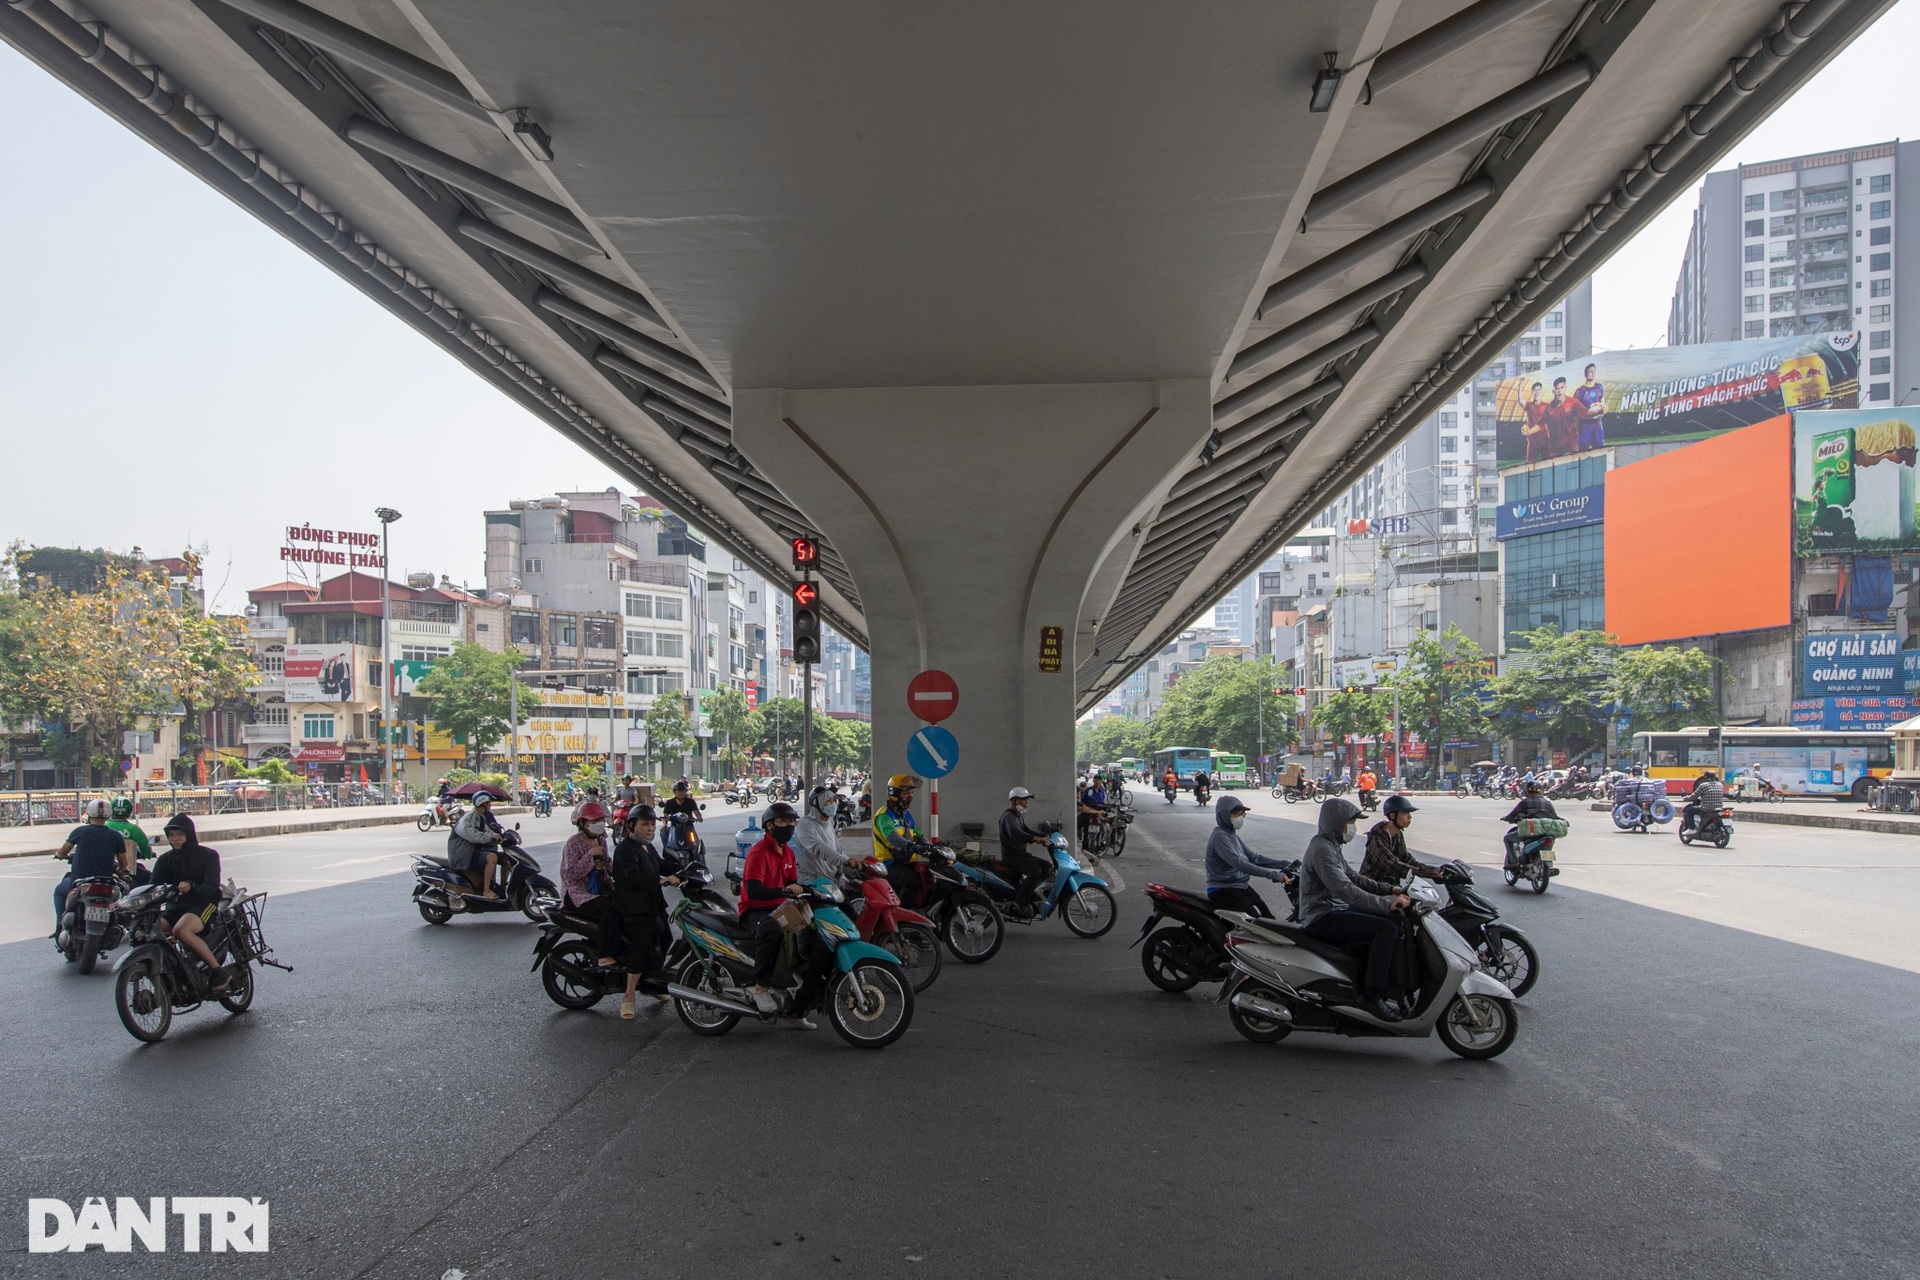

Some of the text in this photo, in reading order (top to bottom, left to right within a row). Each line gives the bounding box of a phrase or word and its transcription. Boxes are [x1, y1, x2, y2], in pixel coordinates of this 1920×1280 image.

[1833, 335, 1851, 346] tcp
[1620, 354, 1779, 410] NĂNG LƯỢNG TÍCH CỰC
[1637, 376, 1768, 425] HÚC TUNG THÁCH THỨC
[1818, 442, 1845, 458] MILO
[1529, 495, 1589, 515] TC Group
[1370, 517, 1411, 534] SHB
[289, 521, 379, 549] ĐỒNG PHỤC
[280, 547, 346, 566] PHƯƠNG
[797, 543, 813, 560] 51
[1808, 633, 1897, 662] CHỢ HẢI SẢN
[1812, 663, 1894, 682] QUẢNG NINH
[1296, 687, 1306, 695] 51
[1846, 684, 1861, 692] ship
[1863, 684, 1880, 692] hàng
[551, 692, 570, 704] CÔNG
[1835, 697, 1856, 708] TÔM
[1862, 698, 1880, 708] CUA
[1887, 698, 1906, 709] GHẸ
[1840, 710, 1853, 721] CÁ
[1860, 711, 1884, 721] NGAO
[531, 718, 573, 731] KÍNH MẮT
[525, 731, 560, 752] VIỆT
[519, 752, 535, 764] HIỆU
[567, 752, 585, 763] KÍNH
